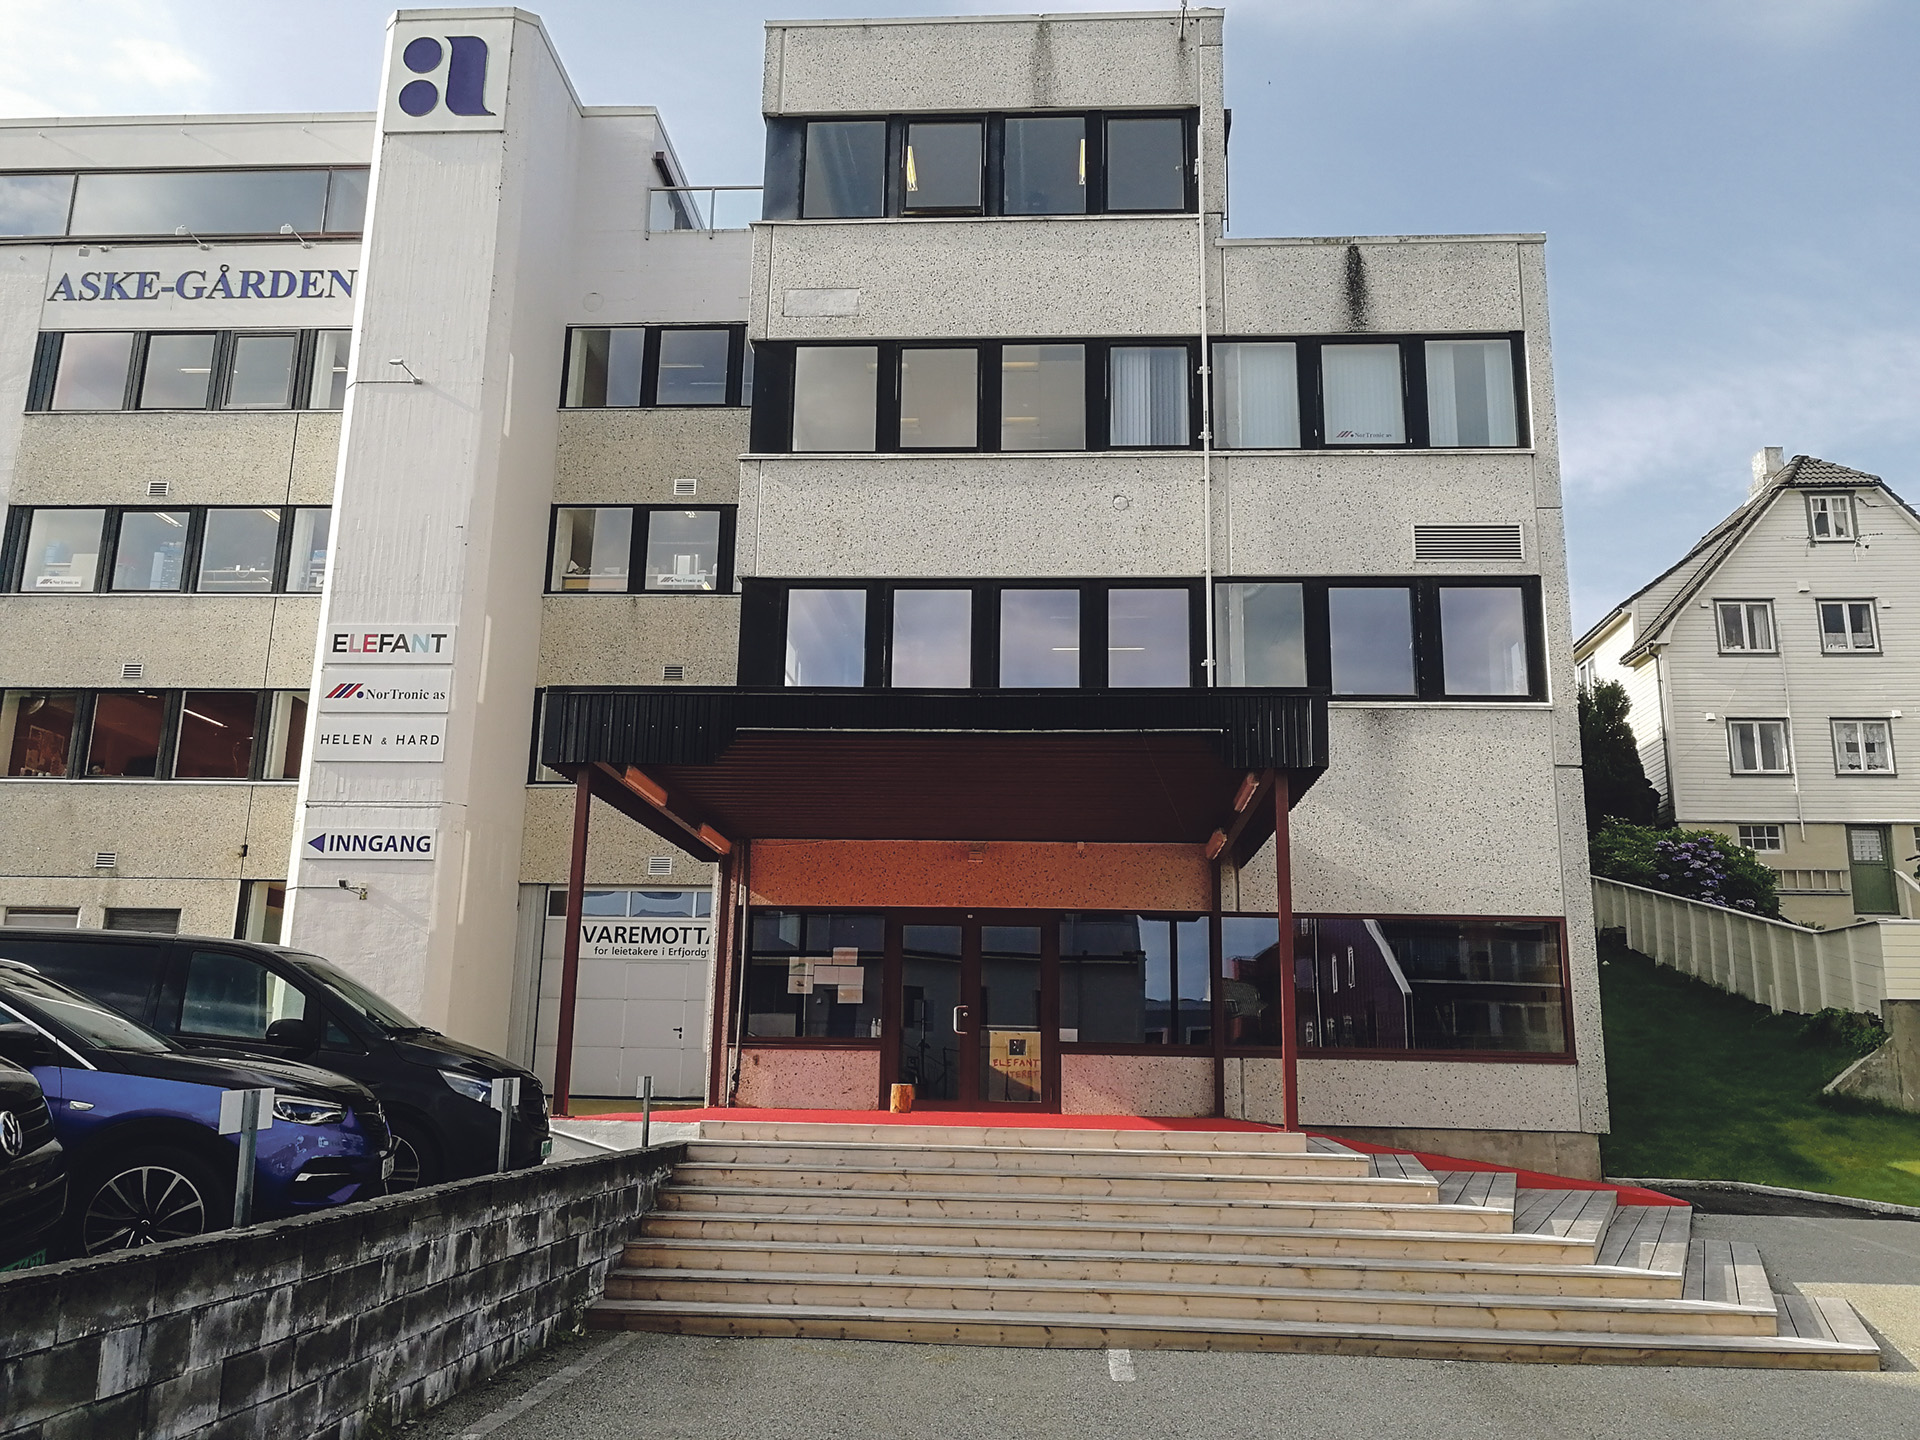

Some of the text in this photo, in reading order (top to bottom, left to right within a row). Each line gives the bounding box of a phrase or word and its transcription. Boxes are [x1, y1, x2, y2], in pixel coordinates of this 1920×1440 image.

[47, 264, 358, 302] ASKE-GÅRDEN
[332, 633, 448, 653] ELEFANT
[366, 688, 446, 700] NorTronic as
[320, 734, 440, 745] HELEN & HARD
[329, 834, 431, 853] INNGANG
[594, 946, 608, 955] for
[612, 946, 658, 956] leietakere
[668, 947, 709, 958] Erfjordg
[992, 1058, 1040, 1068] ELEFANT
